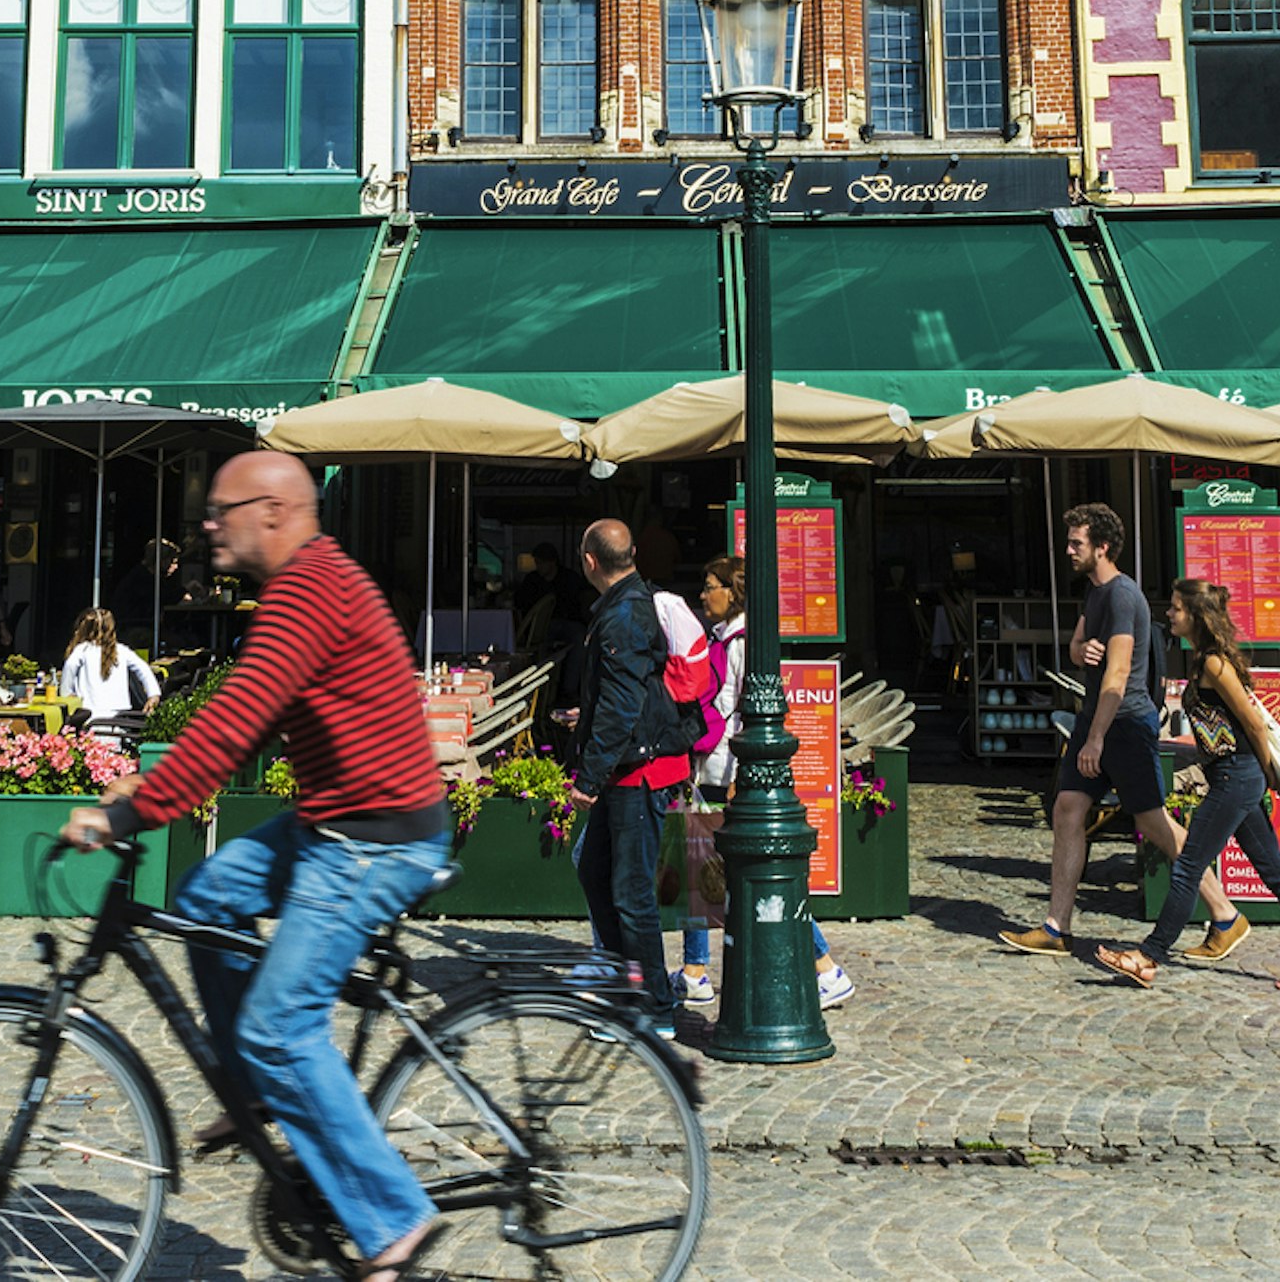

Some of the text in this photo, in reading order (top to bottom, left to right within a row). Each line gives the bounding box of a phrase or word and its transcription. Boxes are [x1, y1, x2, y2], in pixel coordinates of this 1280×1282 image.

[35, 188, 206, 213] SINT JORIS
[680, 163, 794, 214] Cenal
[847, 175, 988, 203] Brasserie
[1227, 882, 1249, 893] FISH
